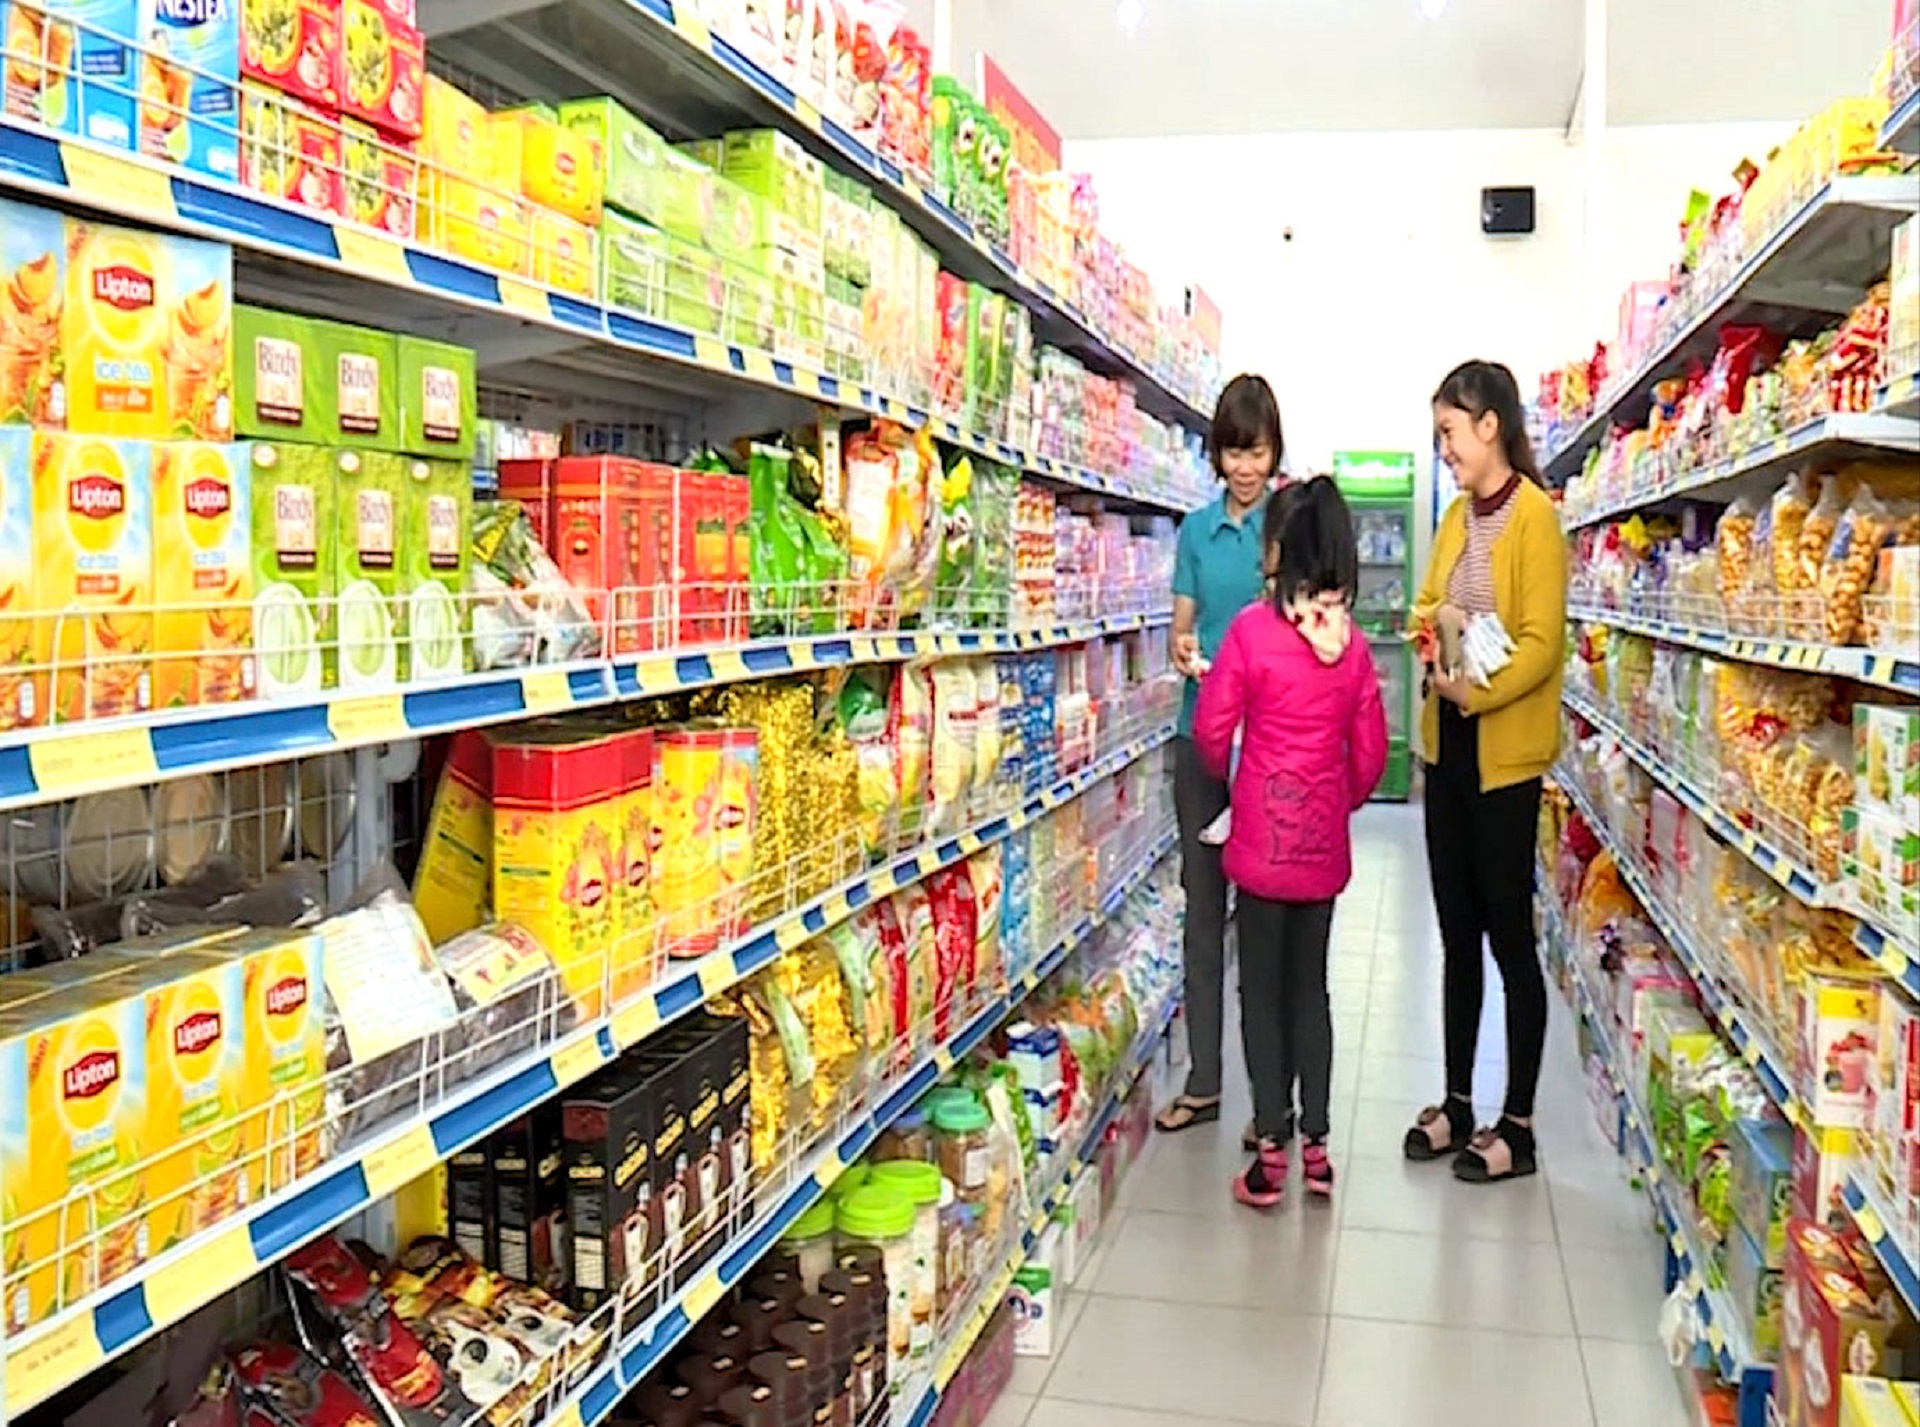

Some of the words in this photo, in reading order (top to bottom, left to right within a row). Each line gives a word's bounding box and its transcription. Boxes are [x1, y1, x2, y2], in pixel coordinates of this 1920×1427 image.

[97, 272, 151, 305] Lipton
[73, 482, 122, 511] Lipton
[187, 484, 226, 511] Lipton
[268, 982, 305, 1012] Lipton
[177, 1017, 217, 1050] Lipton
[67, 1059, 116, 1096] Lipton
